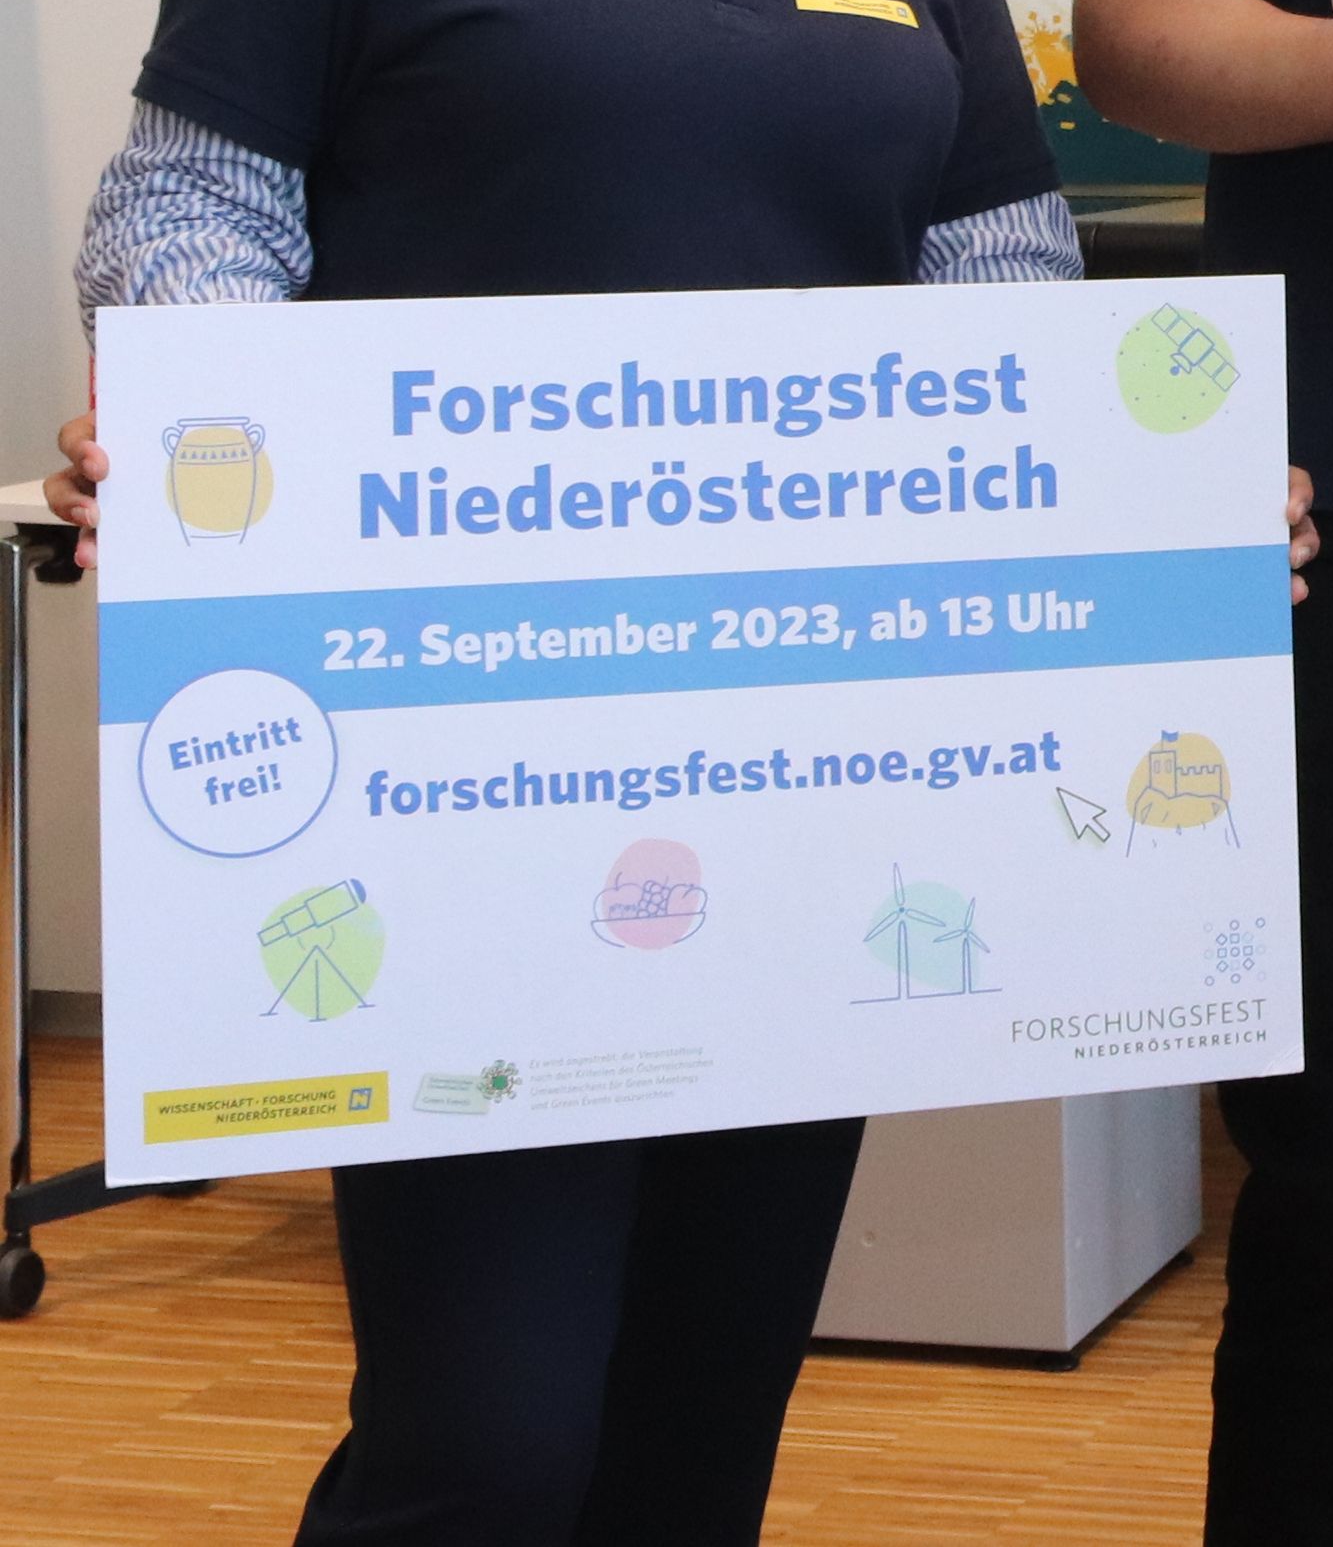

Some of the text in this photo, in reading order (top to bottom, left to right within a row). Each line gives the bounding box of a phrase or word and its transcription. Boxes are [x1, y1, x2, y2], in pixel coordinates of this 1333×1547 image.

[392, 351, 1028, 438] Forschungsfest
[359, 444, 1058, 539] Niederösterreich
[323, 589, 1094, 672] 22. September 2023, ab 13 Uhr
[169, 716, 303, 770] Eintritt
[205, 763, 282, 806] frei!
[365, 731, 1061, 816] forschungsfest.noe.gv.at
[1012, 999, 1266, 1043] FORSCHUNGSFEST
[1075, 1030, 1267, 1059] NIEDERÖSTERREICH
[159, 1090, 336, 1115] WISSENSCHAFT FORSCHUNG
[216, 1104, 336, 1124] NIEDERÖSTERREICH
